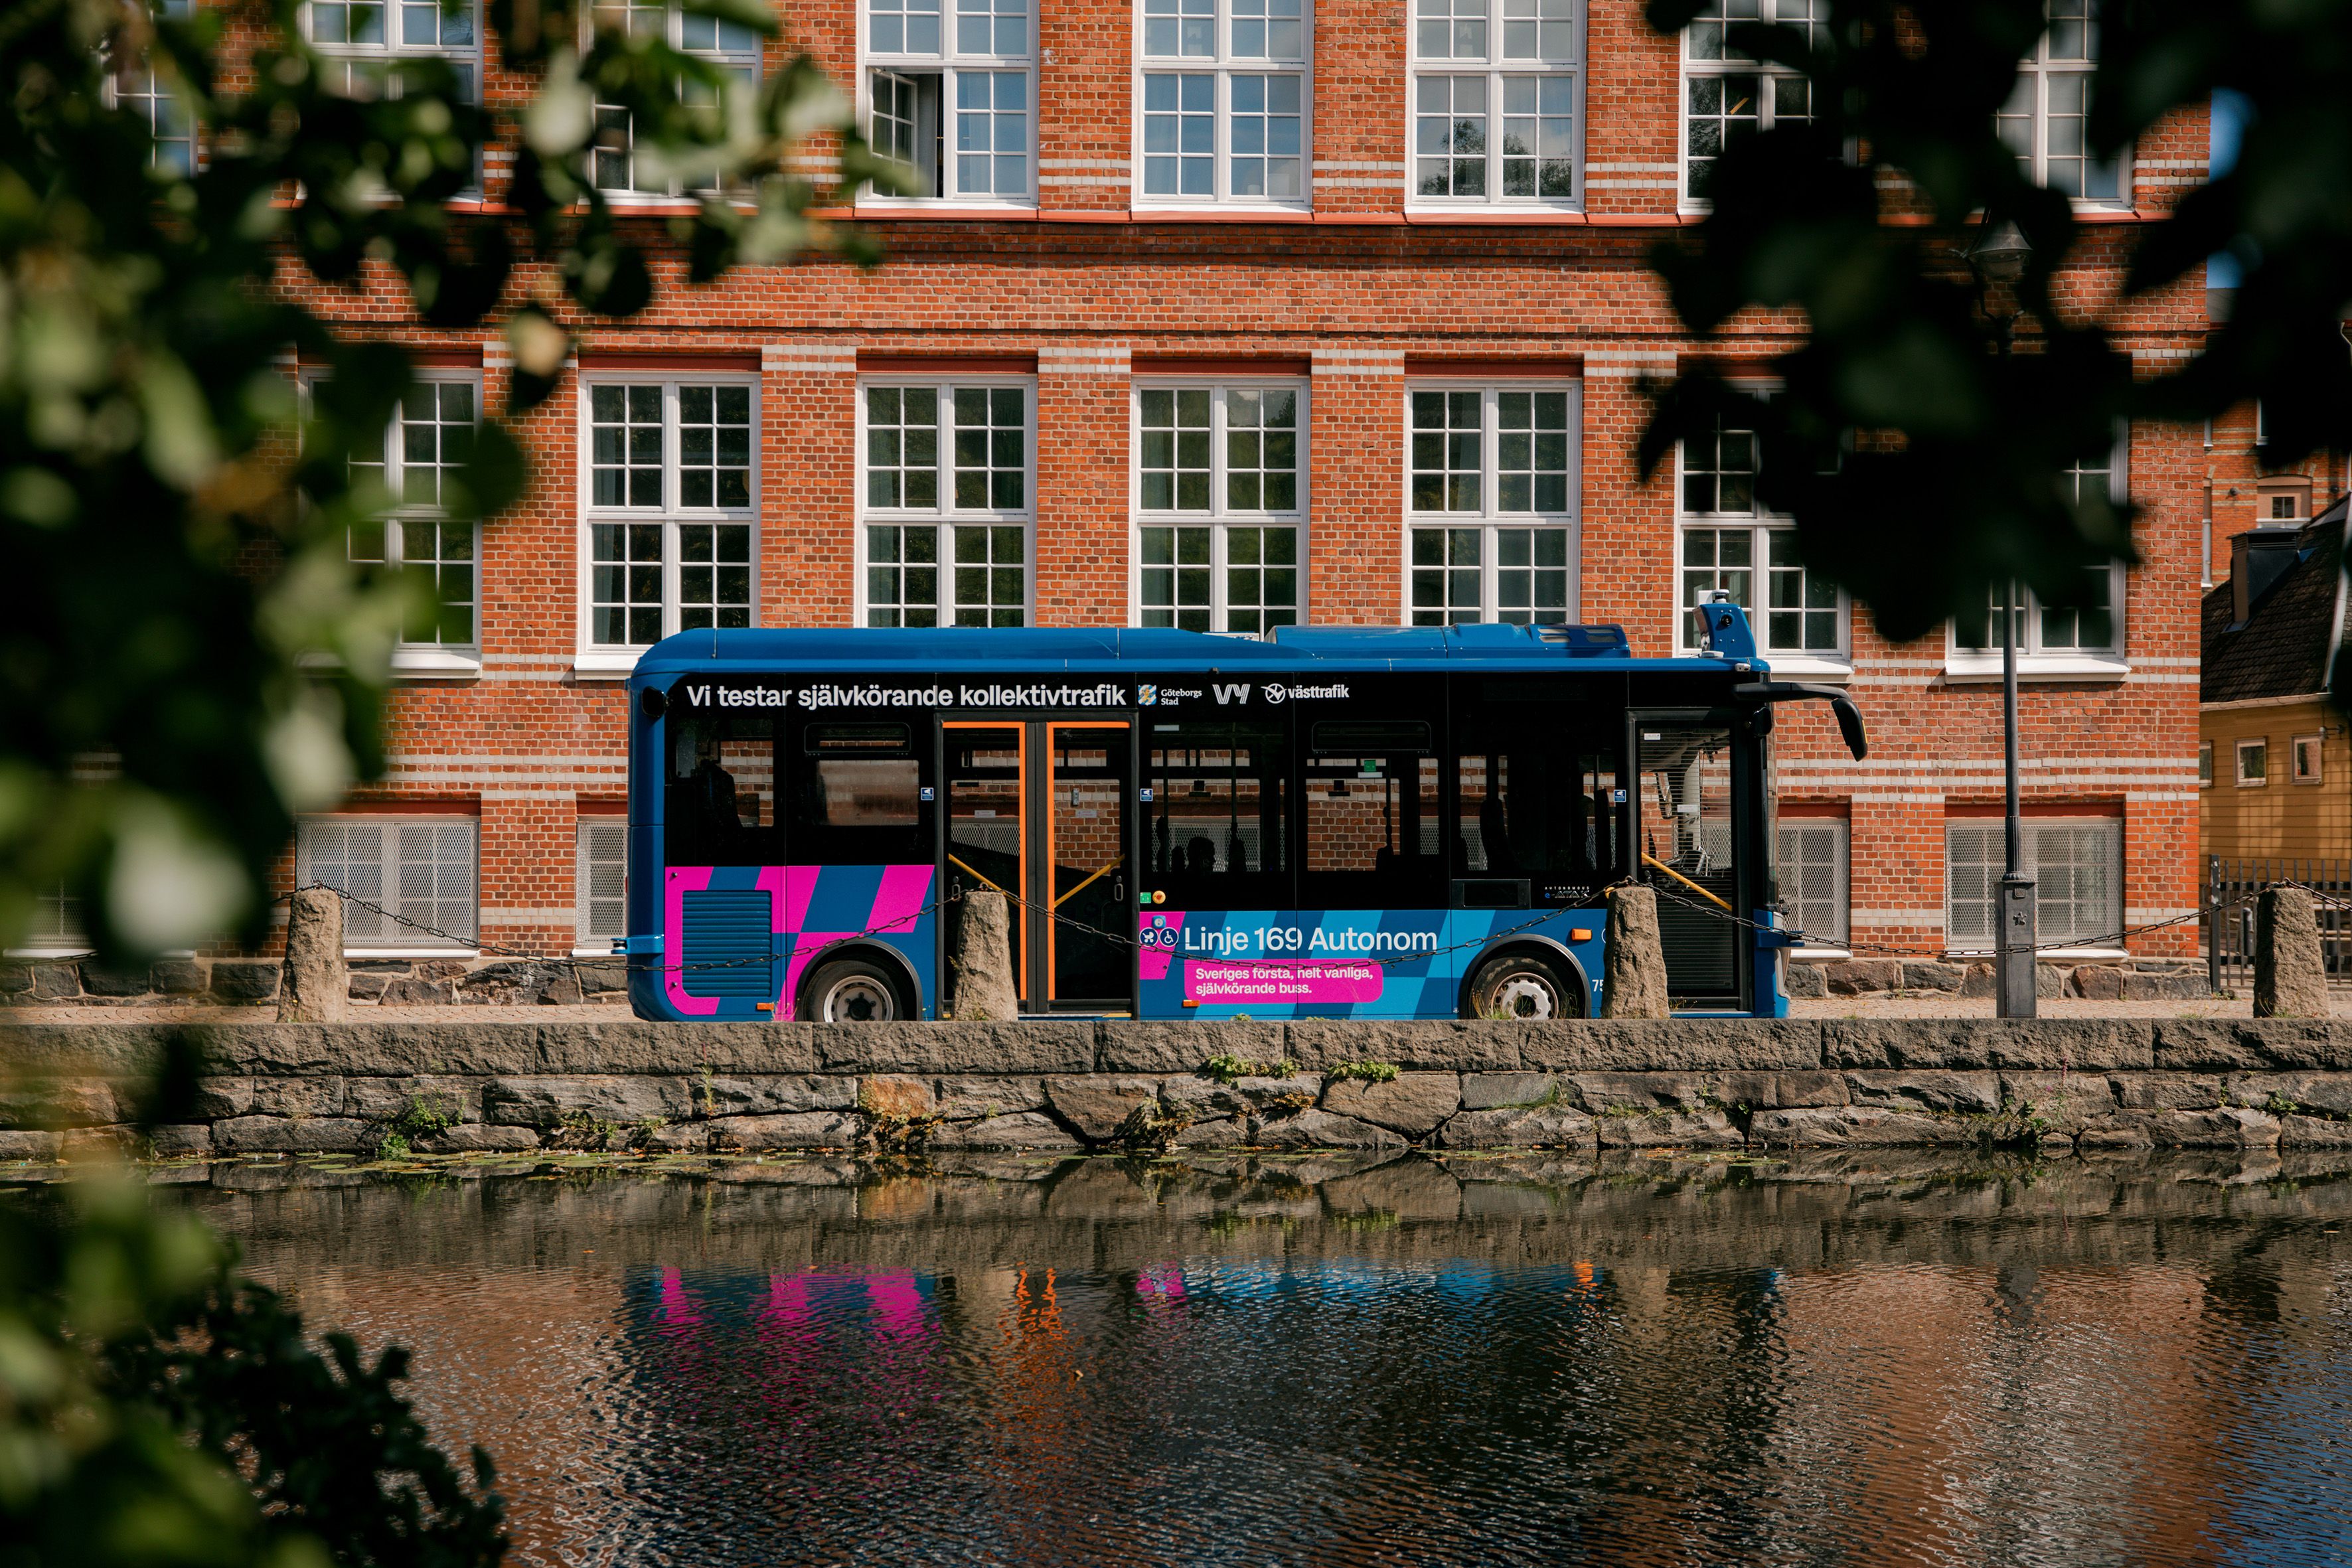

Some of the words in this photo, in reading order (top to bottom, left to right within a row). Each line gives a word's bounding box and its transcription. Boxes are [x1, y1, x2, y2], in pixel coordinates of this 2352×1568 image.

[686, 684, 712, 707] Vi
[716, 684, 793, 707] testar
[797, 684, 954, 711] självkörande
[960, 684, 1127, 706] kollektivtrafik
[1160, 688, 1202, 698] Göteborgs
[1288, 684, 1350, 699] västtrafik
[1160, 697, 1179, 706] Stad
[1184, 927, 1249, 956] Linje
[1254, 927, 1303, 951] 169
[1308, 927, 1437, 951] Autonom
[1196, 967, 1249, 981] Sveriges
[1252, 966, 1295, 982] första,
[1297, 967, 1322, 979] helt
[1324, 967, 1373, 980] vanliga,
[1196, 982, 1276, 997] självkörande
[1279, 982, 1312, 994] buss.
